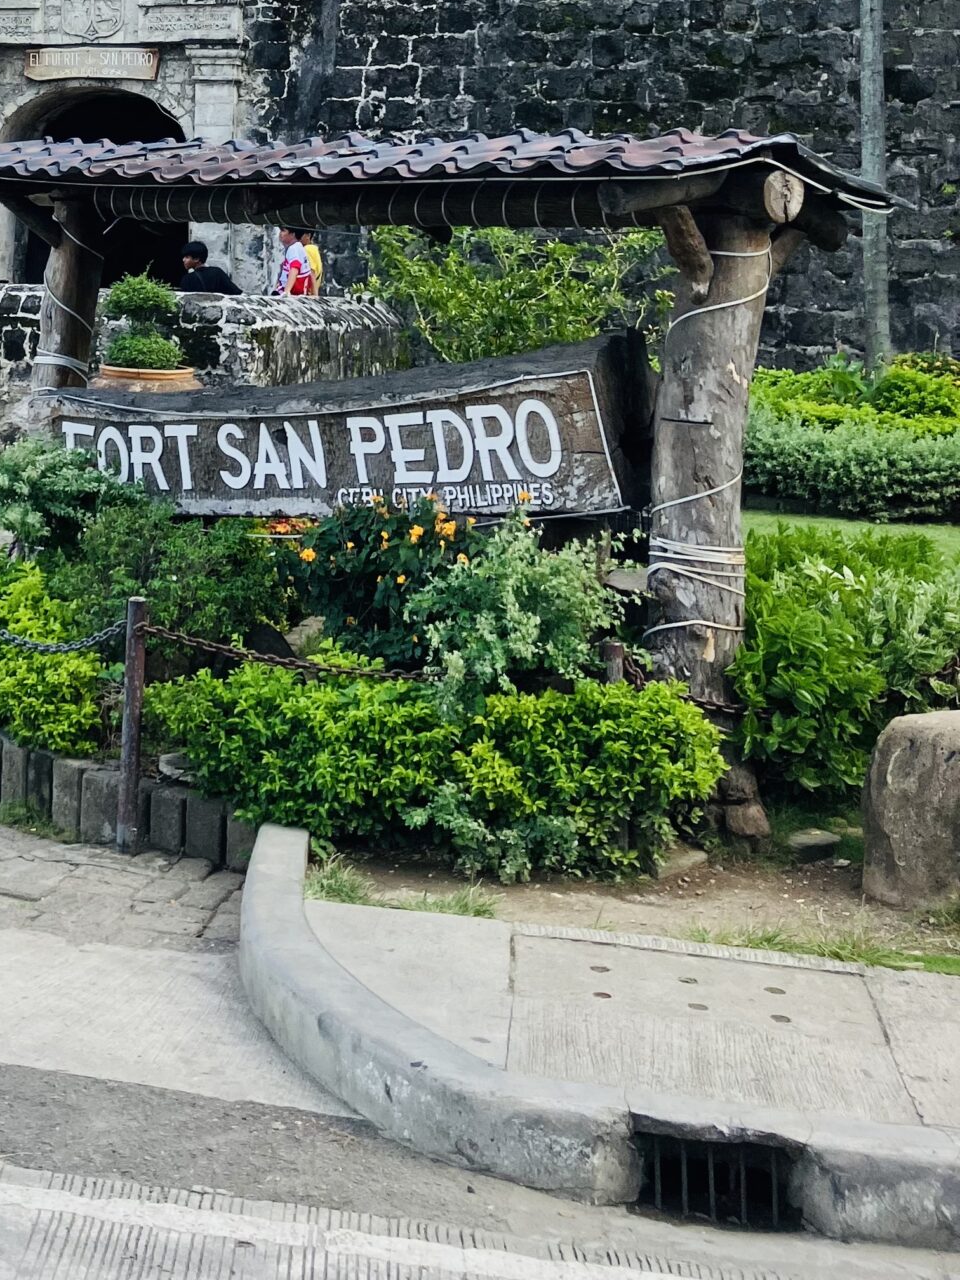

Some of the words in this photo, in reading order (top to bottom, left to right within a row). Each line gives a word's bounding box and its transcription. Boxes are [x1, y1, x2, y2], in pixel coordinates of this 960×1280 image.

[29, 52, 41, 66] EL
[100, 51, 118, 65] SAN
[121, 51, 153, 66] PEDRO
[217, 419, 328, 490] SAN
[346, 398, 563, 484] PEDRO
[337, 487, 385, 509] CEBU
[392, 487, 434, 509] CITY
[443, 483, 554, 508] PHILIPPINES
